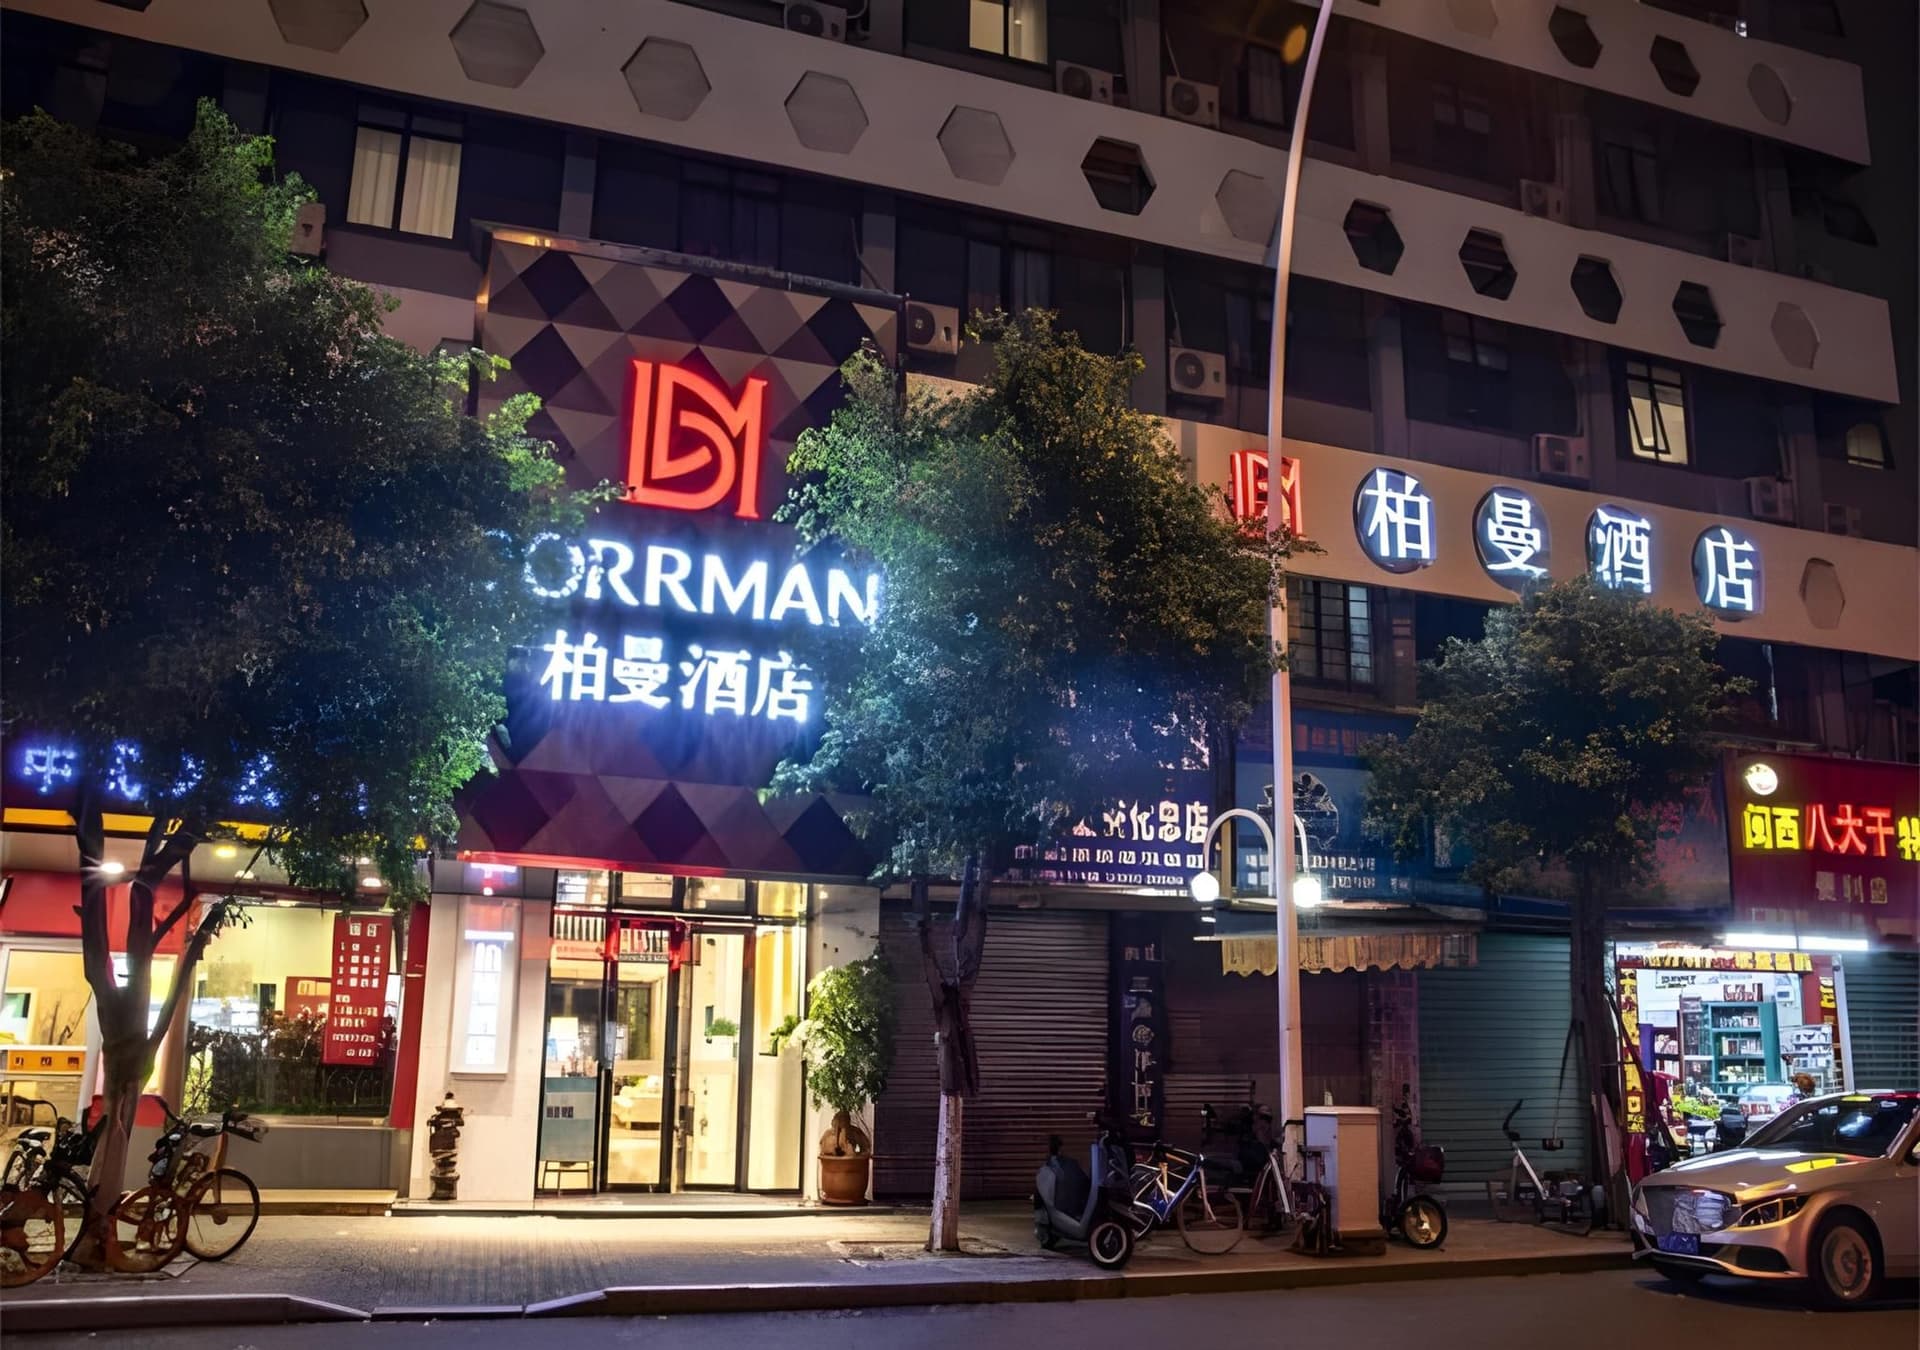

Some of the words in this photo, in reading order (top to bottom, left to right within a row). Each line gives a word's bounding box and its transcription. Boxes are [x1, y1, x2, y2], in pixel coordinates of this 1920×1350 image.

[484, 531, 880, 627] ORRMAN
[1366, 468, 1756, 612] 柏曼酒店
[540, 629, 813, 722] 柏曼酒店
